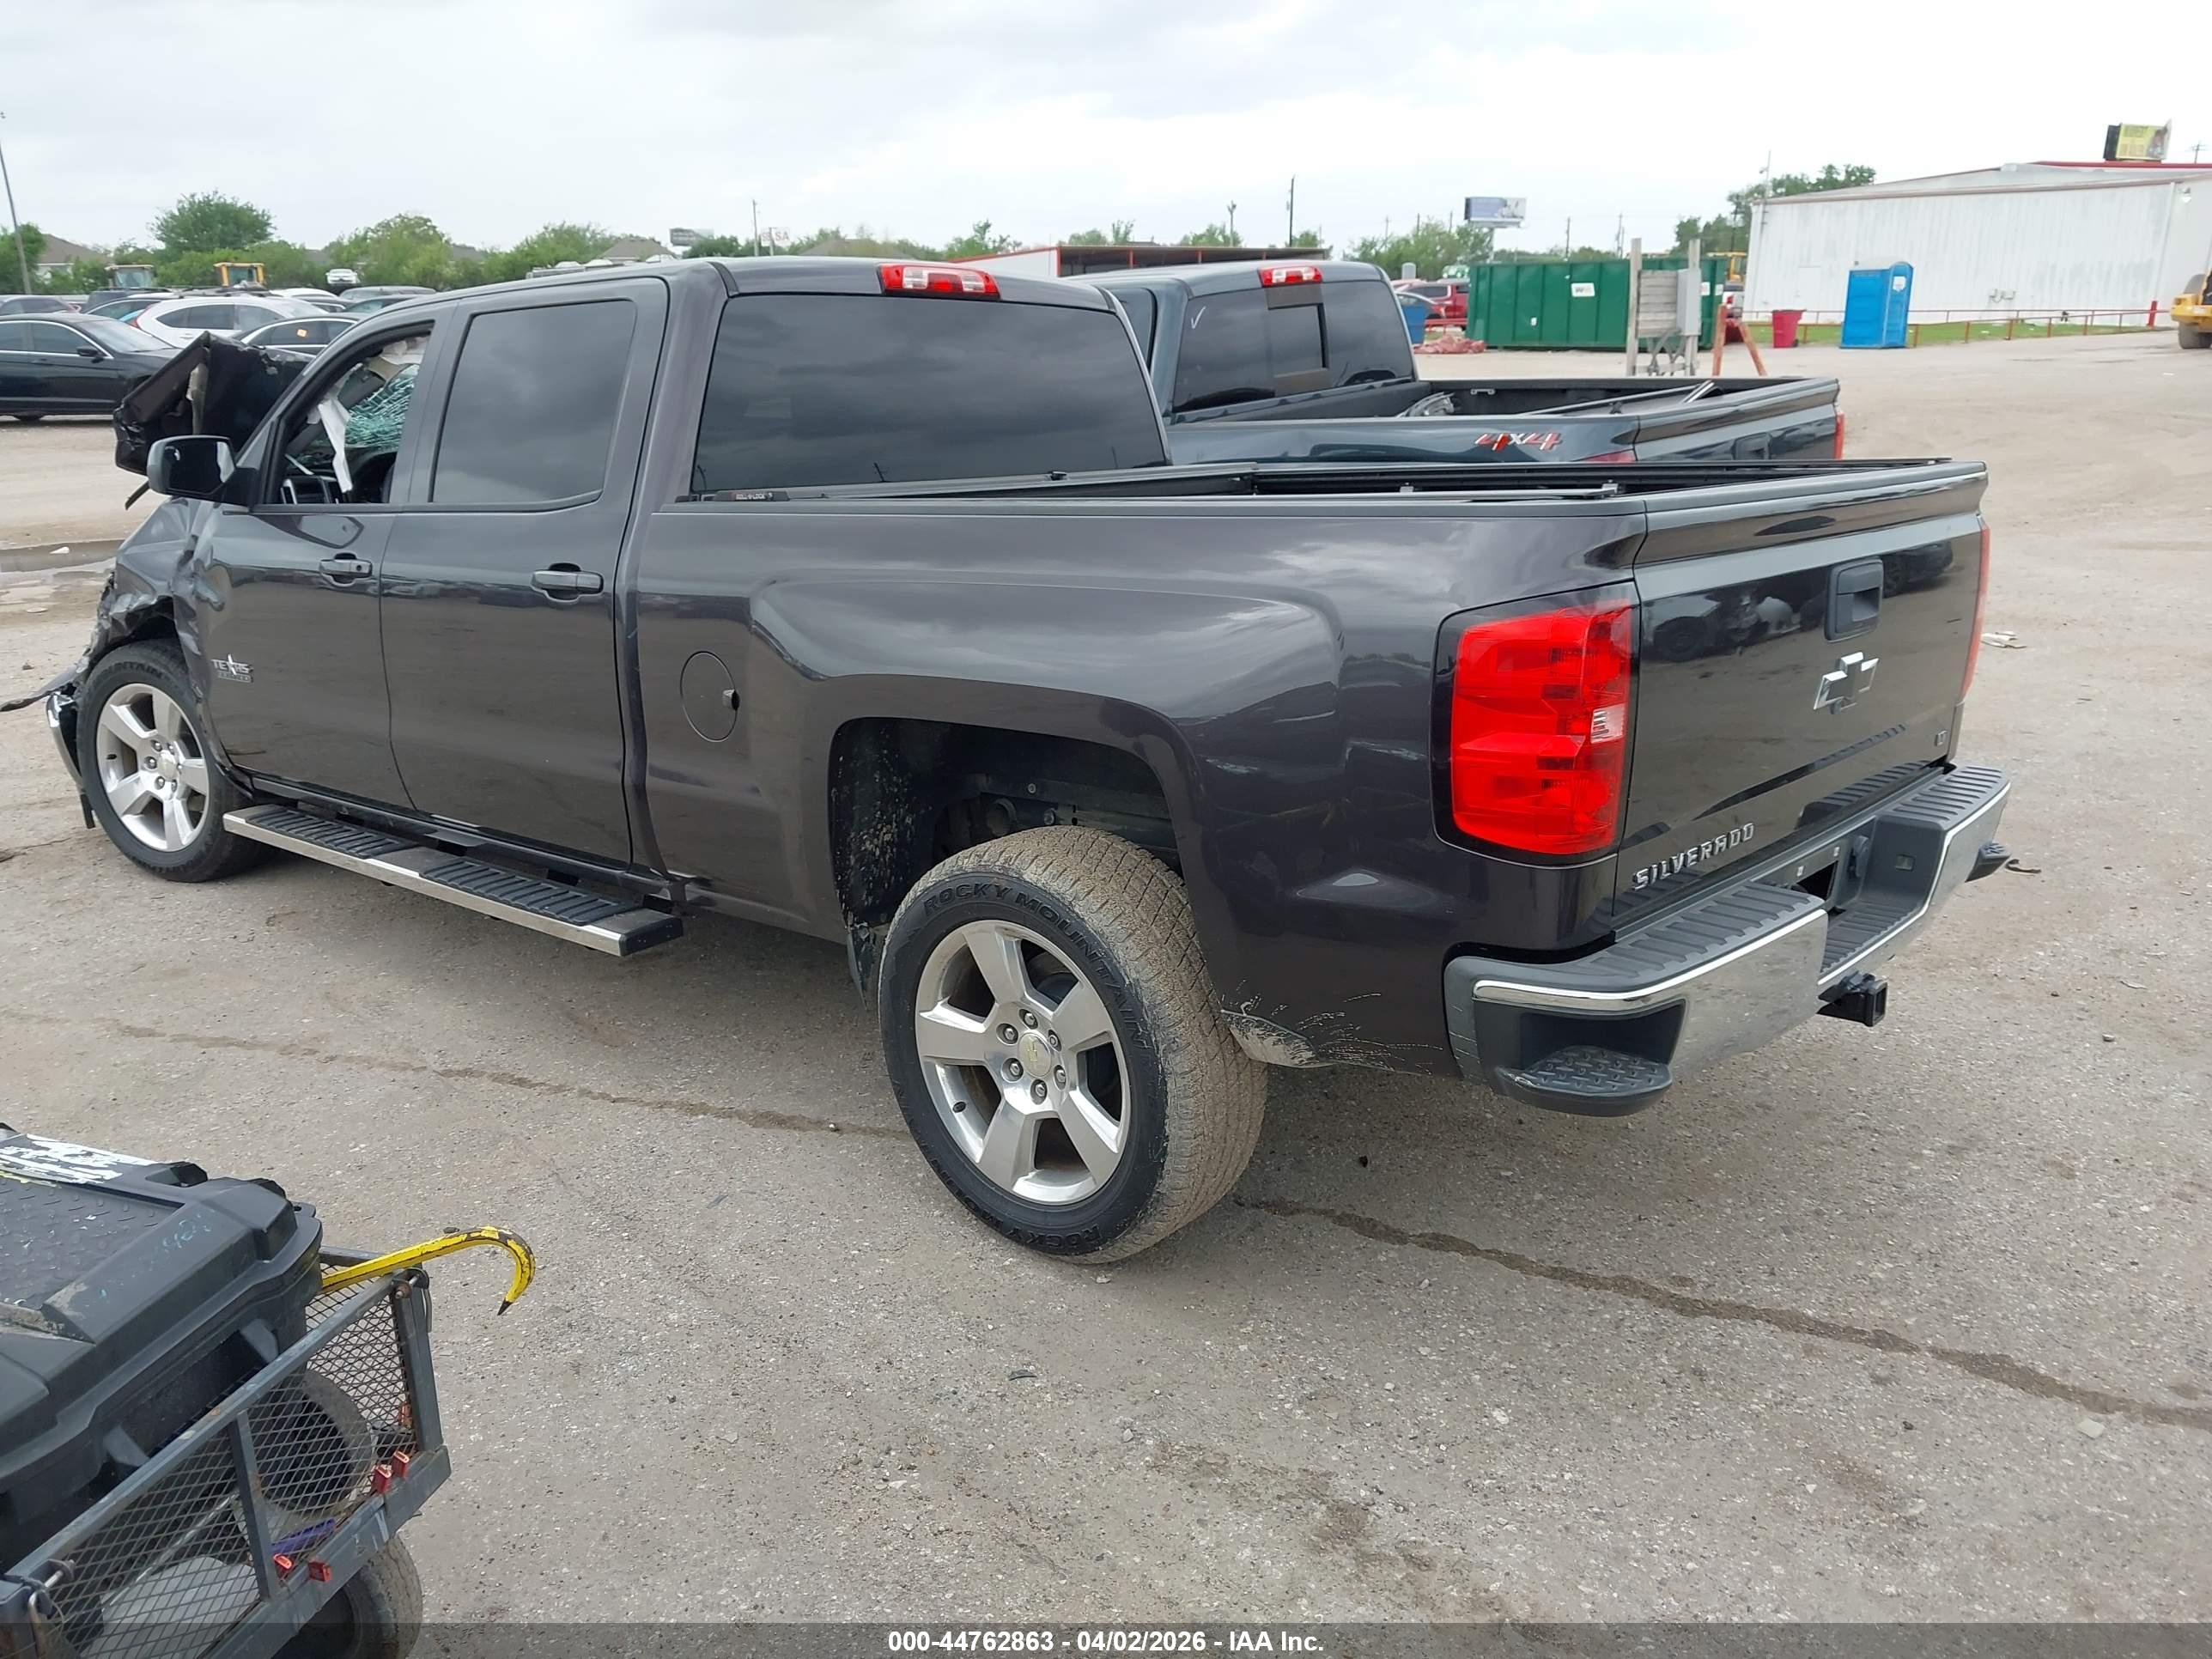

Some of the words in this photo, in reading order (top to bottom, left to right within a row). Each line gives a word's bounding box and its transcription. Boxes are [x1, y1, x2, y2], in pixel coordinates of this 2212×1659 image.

[1632, 822, 1755, 892] SILVERADO
[923, 882, 1013, 916] ROCKY
[1014, 891, 1153, 1050] MOUNTAIN
